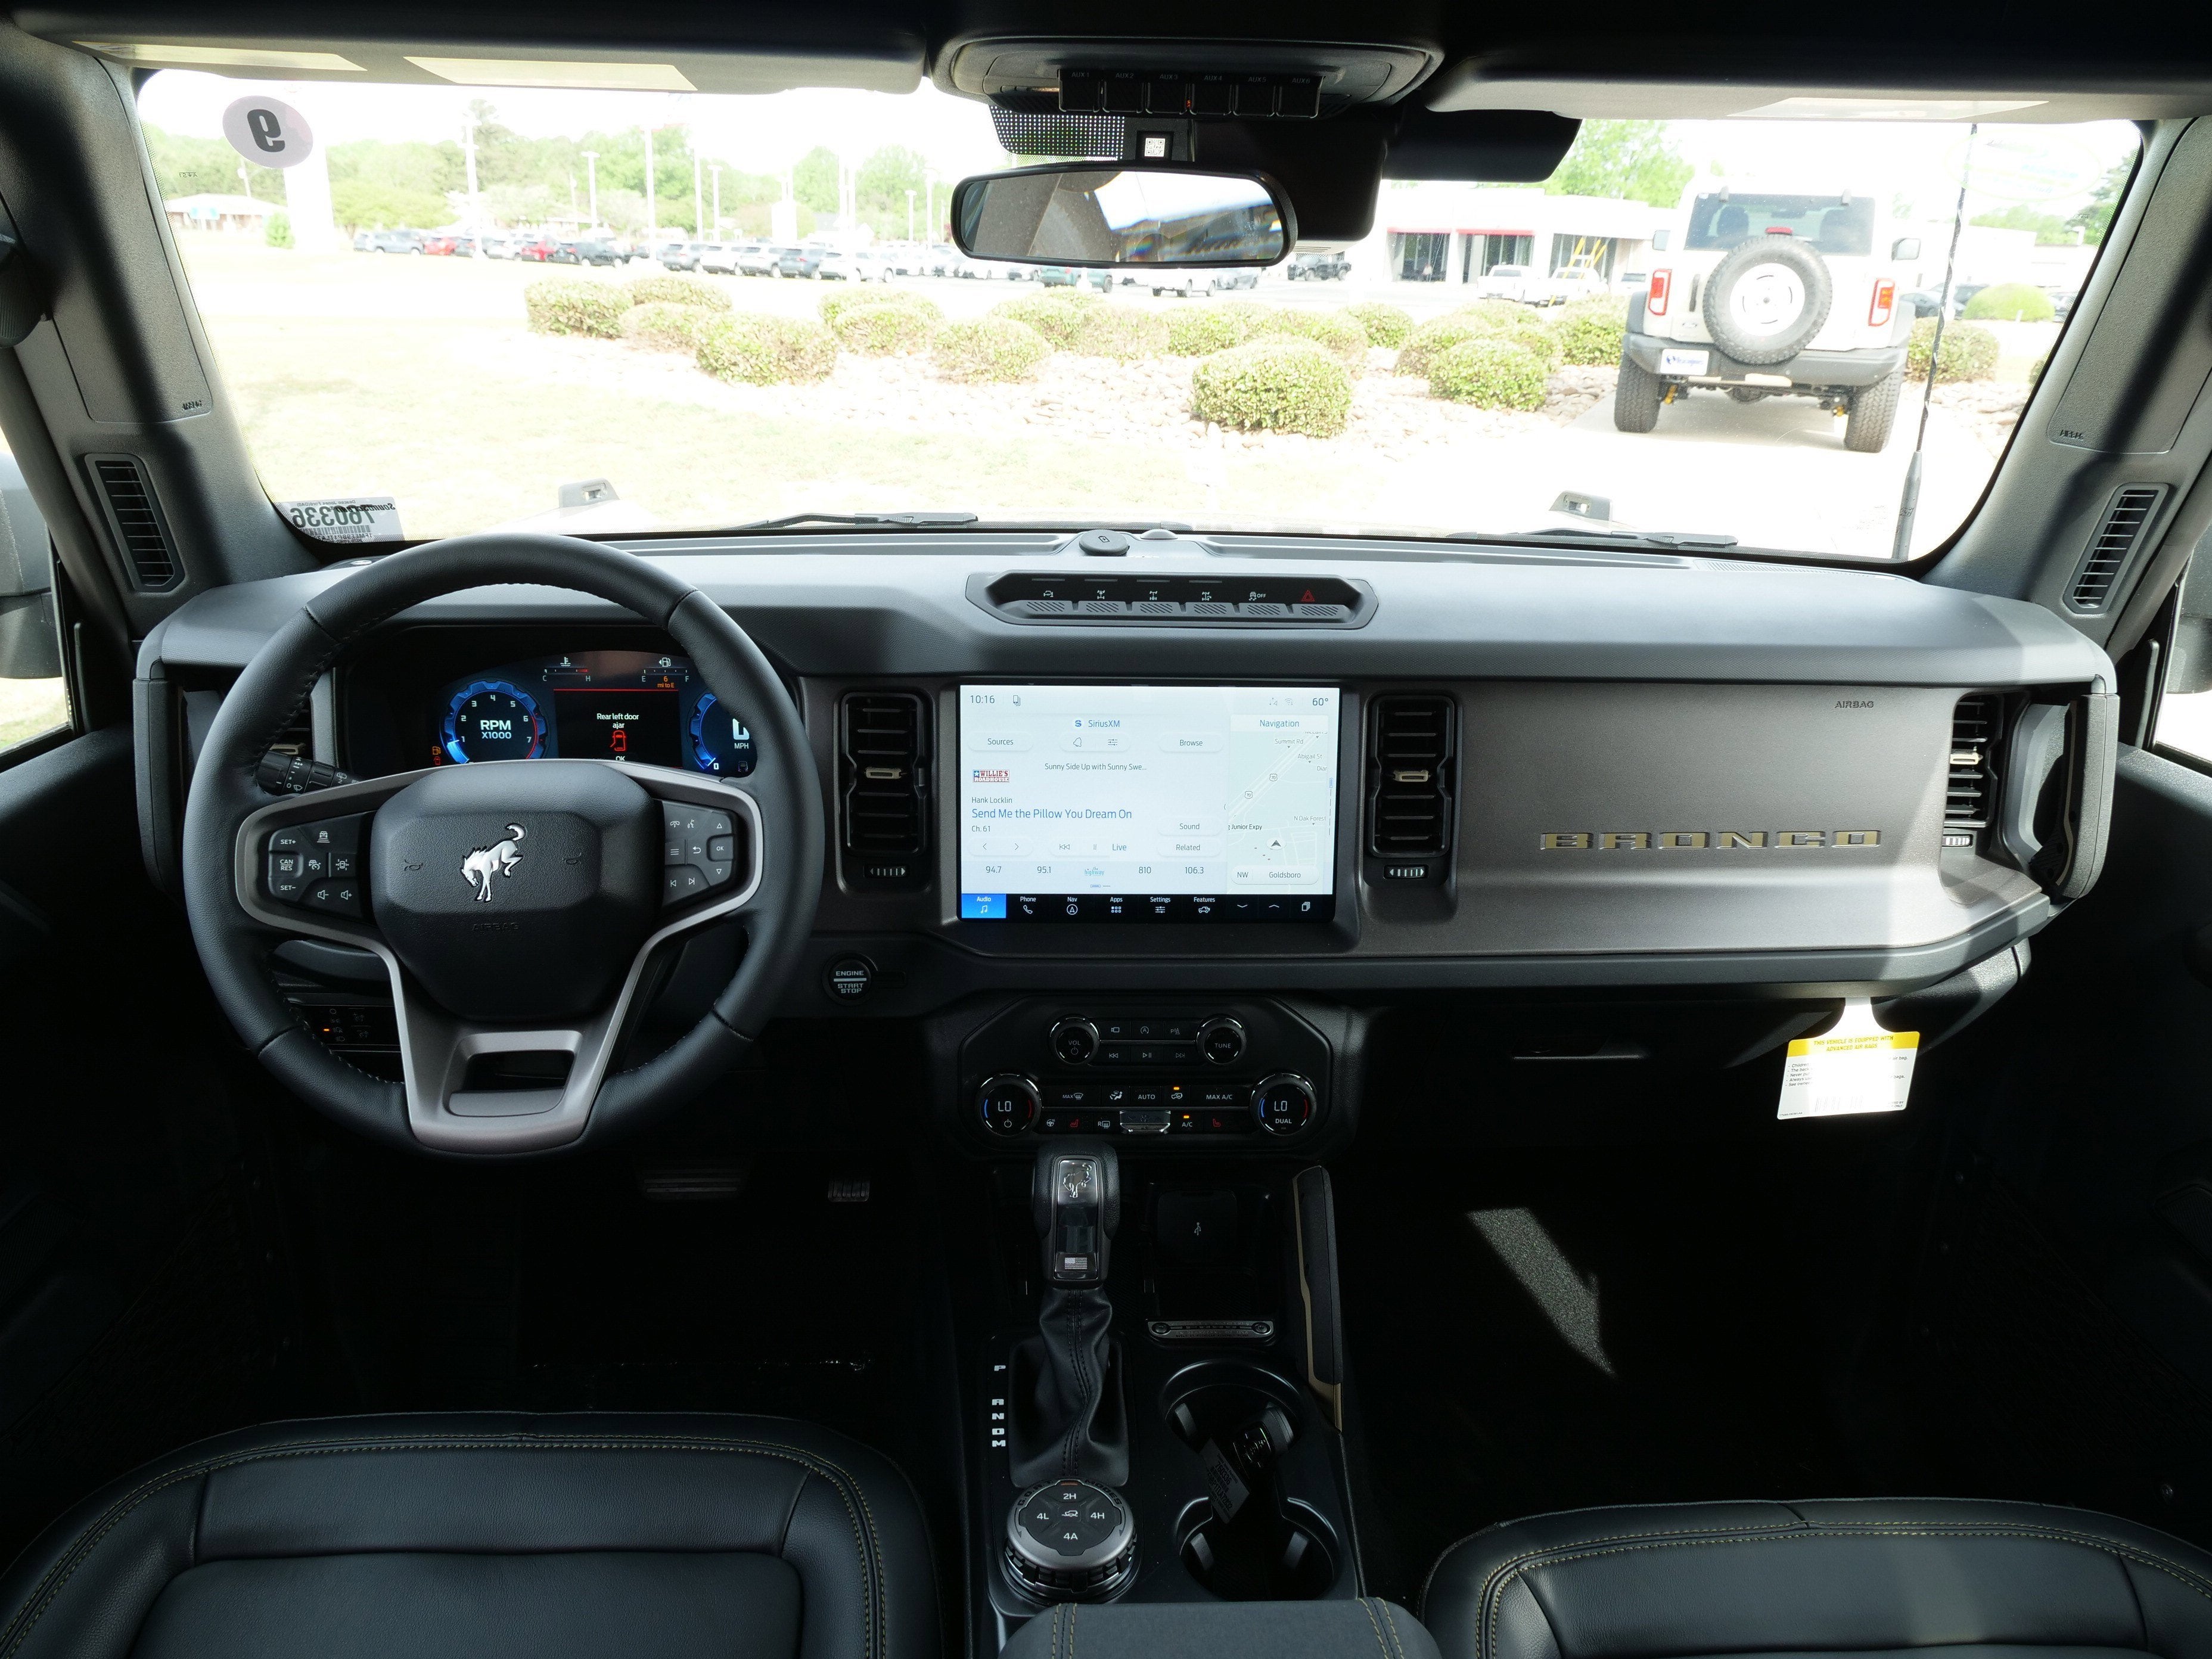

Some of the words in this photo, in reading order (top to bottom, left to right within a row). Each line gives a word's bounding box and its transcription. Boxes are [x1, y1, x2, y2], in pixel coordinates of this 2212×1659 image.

[970, 695, 996, 704] 10:16
[1312, 697, 1329, 706] 60°
[1834, 700, 1874, 709] AIRBAG
[480, 720, 511, 731] RPM
[1088, 719, 1120, 728] SiriusXM
[1259, 719, 1300, 729] Navigation
[481, 731, 512, 740] X1000
[1045, 763, 1065, 771] Sunny
[1081, 763, 1091, 771] Up
[1107, 763, 1127, 771] Sunny
[972, 808, 996, 818] Send
[998, 809, 1012, 818] Me
[1014, 809, 1031, 818] the
[1033, 809, 1062, 818] Pillow
[1064, 809, 1083, 819] You
[1085, 809, 1117, 819] Dream
[1119, 809, 1133, 819] On
[1540, 829, 1881, 851] BRONCO
[998, 1101, 1011, 1112] LO
[1274, 1101, 1287, 1111] LO
[1217, 1461, 1232, 1485] 760336
[1085, 1479, 1123, 1506] MODES
